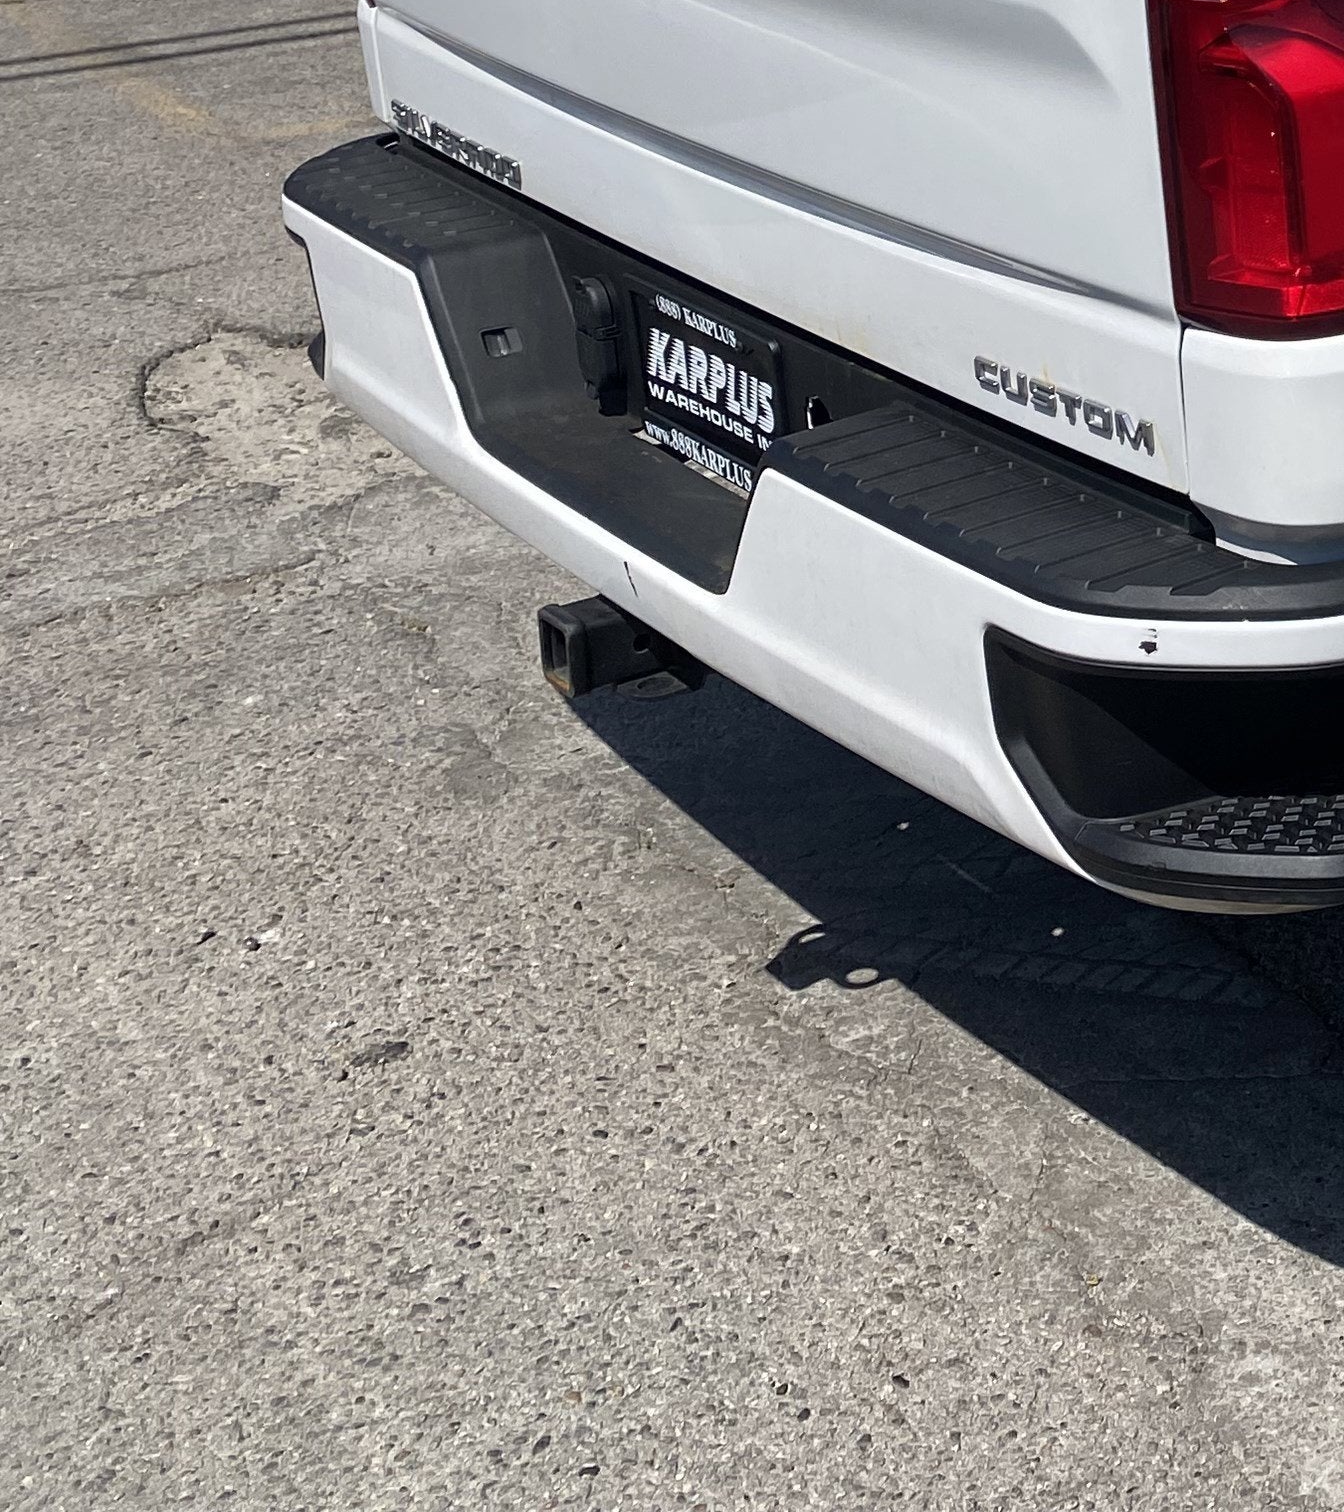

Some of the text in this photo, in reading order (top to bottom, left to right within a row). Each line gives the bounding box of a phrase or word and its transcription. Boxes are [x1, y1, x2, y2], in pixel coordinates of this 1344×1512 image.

[655, 293, 737, 349] (888) KARPLUS
[646, 327, 775, 434] KARPLUS
[647, 380, 755, 445] WAREHOUSE
[973, 355, 1156, 458] CUSTOM
